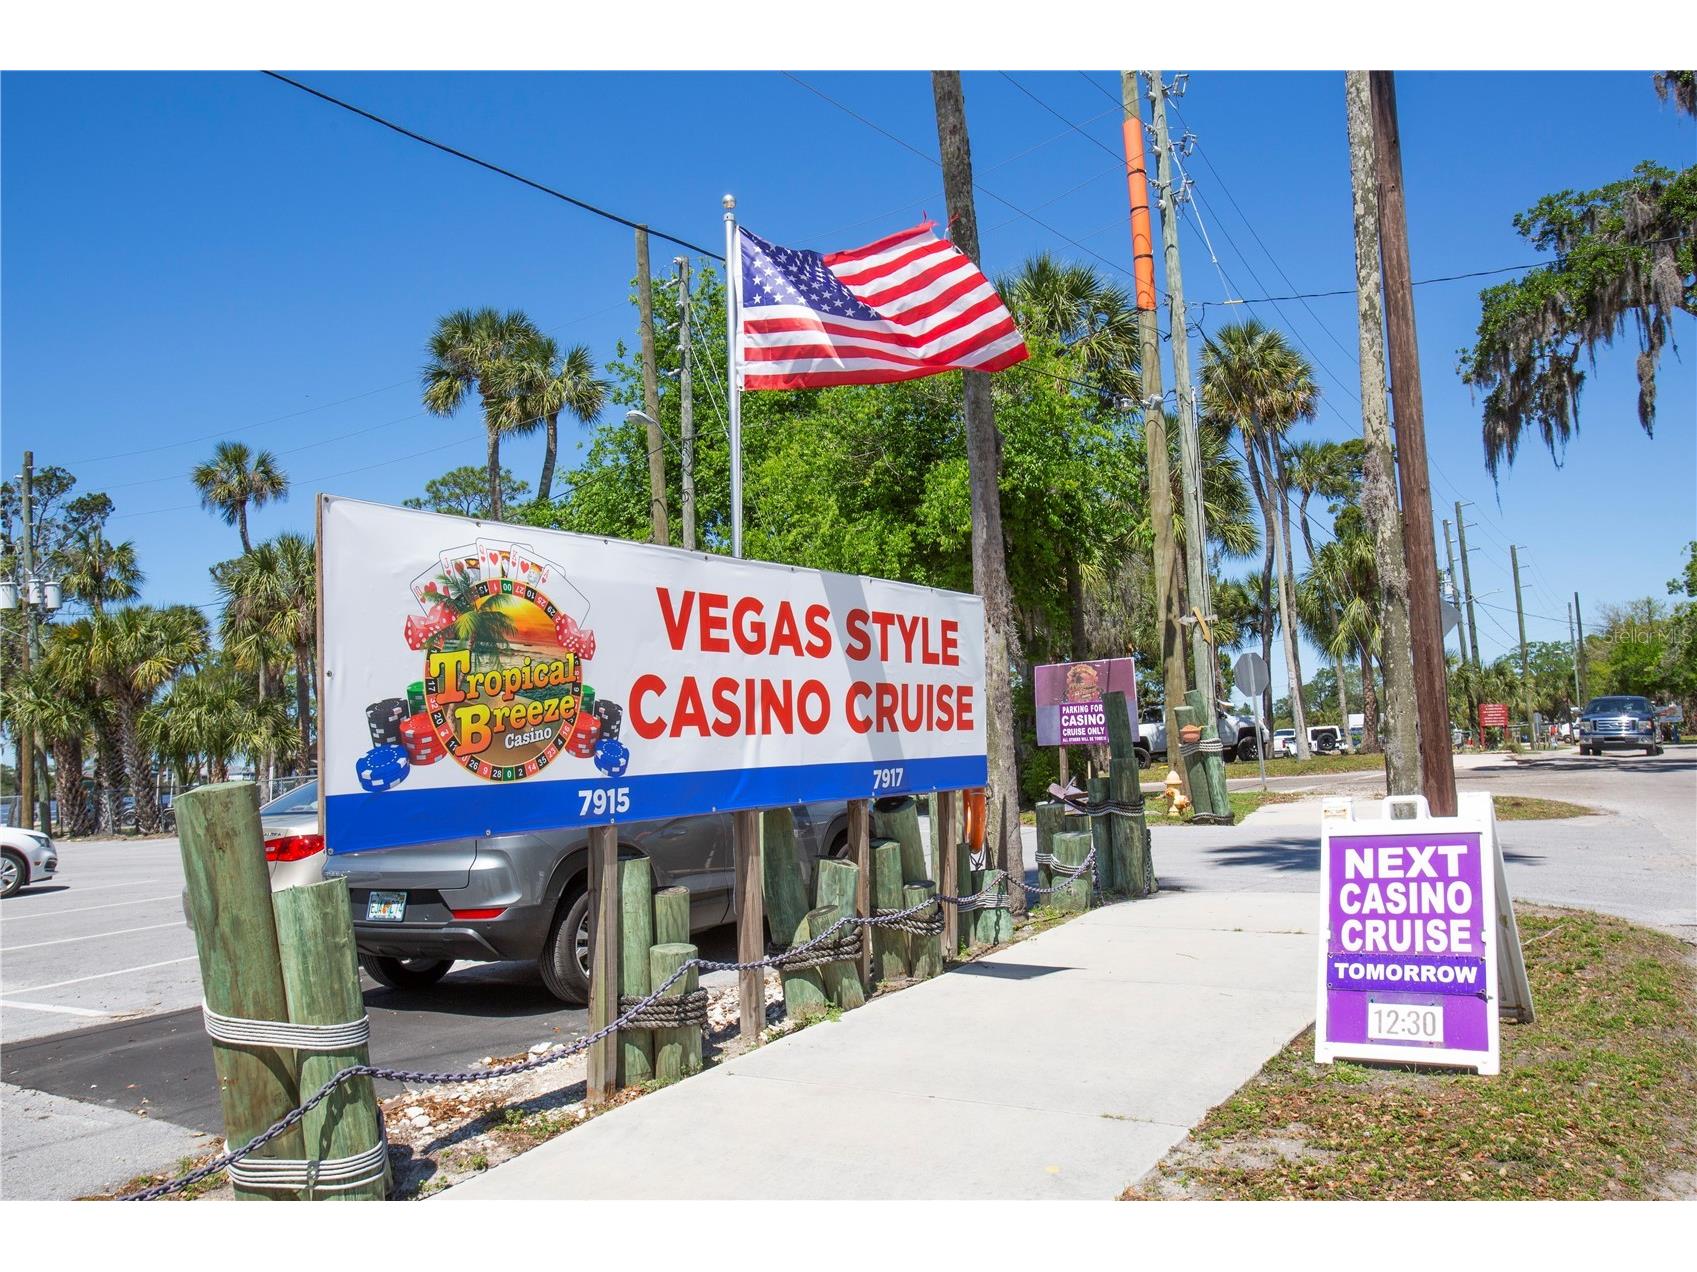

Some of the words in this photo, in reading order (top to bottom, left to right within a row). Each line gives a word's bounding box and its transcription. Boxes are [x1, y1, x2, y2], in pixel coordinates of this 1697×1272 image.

[502, 583, 512, 592] 00
[656, 587, 832, 659] VEGAS
[845, 608, 959, 666] STYLE
[430, 650, 577, 705] Tropical
[629, 673, 830, 740] CASINO
[845, 681, 974, 733] CRUISE
[1062, 705, 1088, 714] PARKING
[1090, 704, 1103, 713] FOR
[455, 695, 575, 757] Breeze
[1061, 713, 1105, 726] CASINO
[1062, 727, 1086, 736] CRUISE
[1087, 726, 1105, 735] ONLY
[505, 727, 552, 749] Casino
[468, 760, 478, 770] 26
[492, 769, 502, 778] 28
[873, 767, 903, 789] 7917
[578, 787, 630, 817] 7915
[1344, 845, 1468, 880] NEXT
[1339, 881, 1473, 915] CASINO
[1341, 919, 1473, 953] CRUISE
[1334, 962, 1478, 984] TOMORROW
[1375, 1008, 1437, 1037] 12:30
